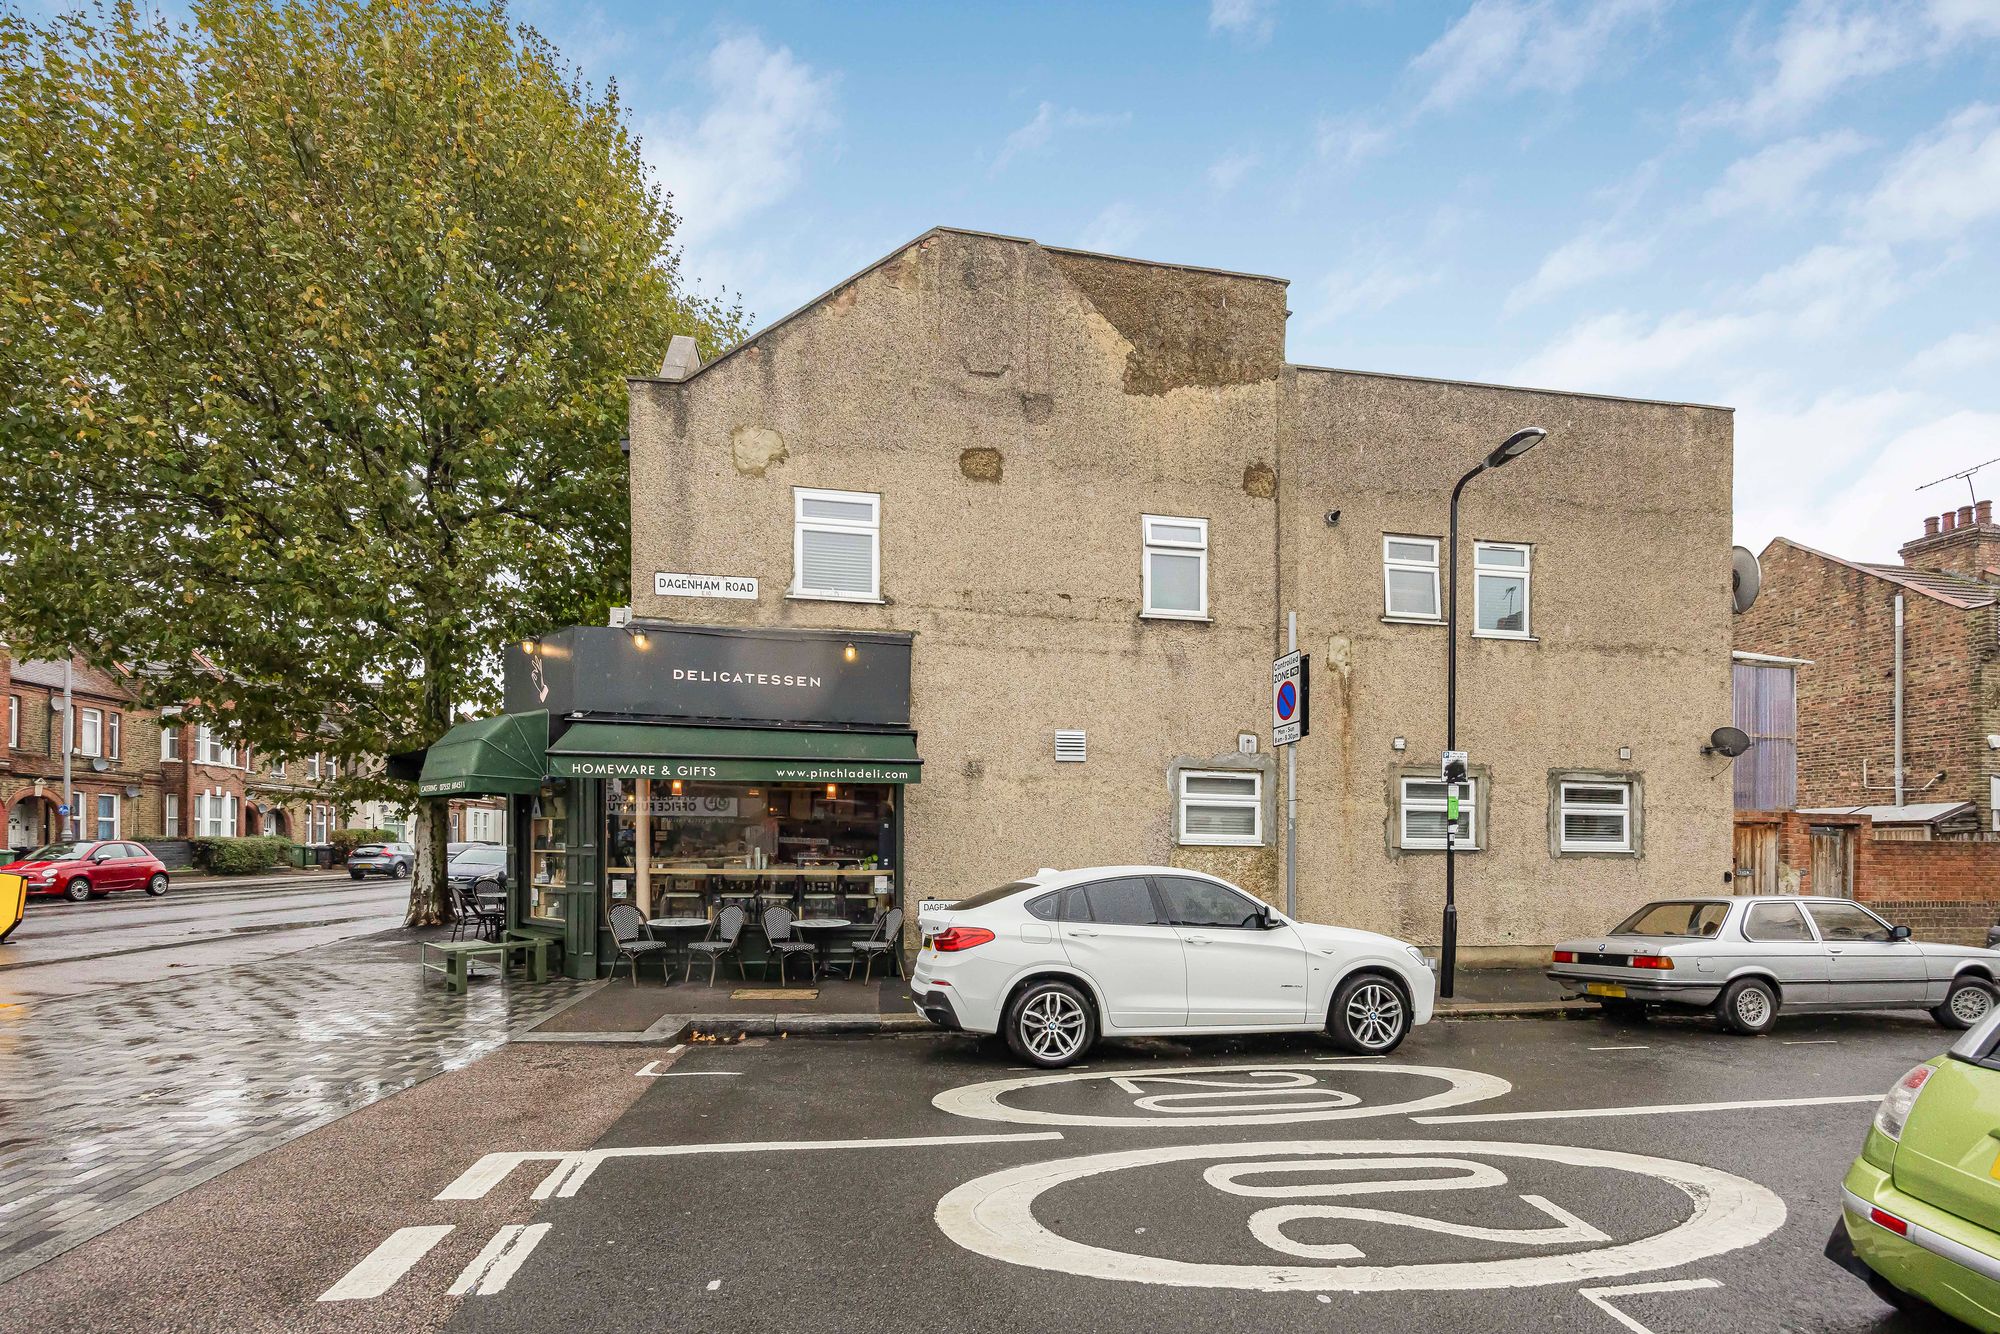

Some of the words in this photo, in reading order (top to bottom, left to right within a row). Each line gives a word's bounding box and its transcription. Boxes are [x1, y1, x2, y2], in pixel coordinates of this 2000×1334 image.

[659, 578, 720, 590] DAGENHAM
[725, 582, 754, 592] ROAD
[1274, 655, 1298, 671] Controlled
[673, 669, 821, 687] DELICATESSEN
[1274, 669, 1290, 683] ZONE
[572, 763, 655, 775] HOMEWARE
[661, 766, 671, 775] &
[677, 765, 716, 776] GIFTS
[776, 768, 908, 780] www.pinchladeli.com
